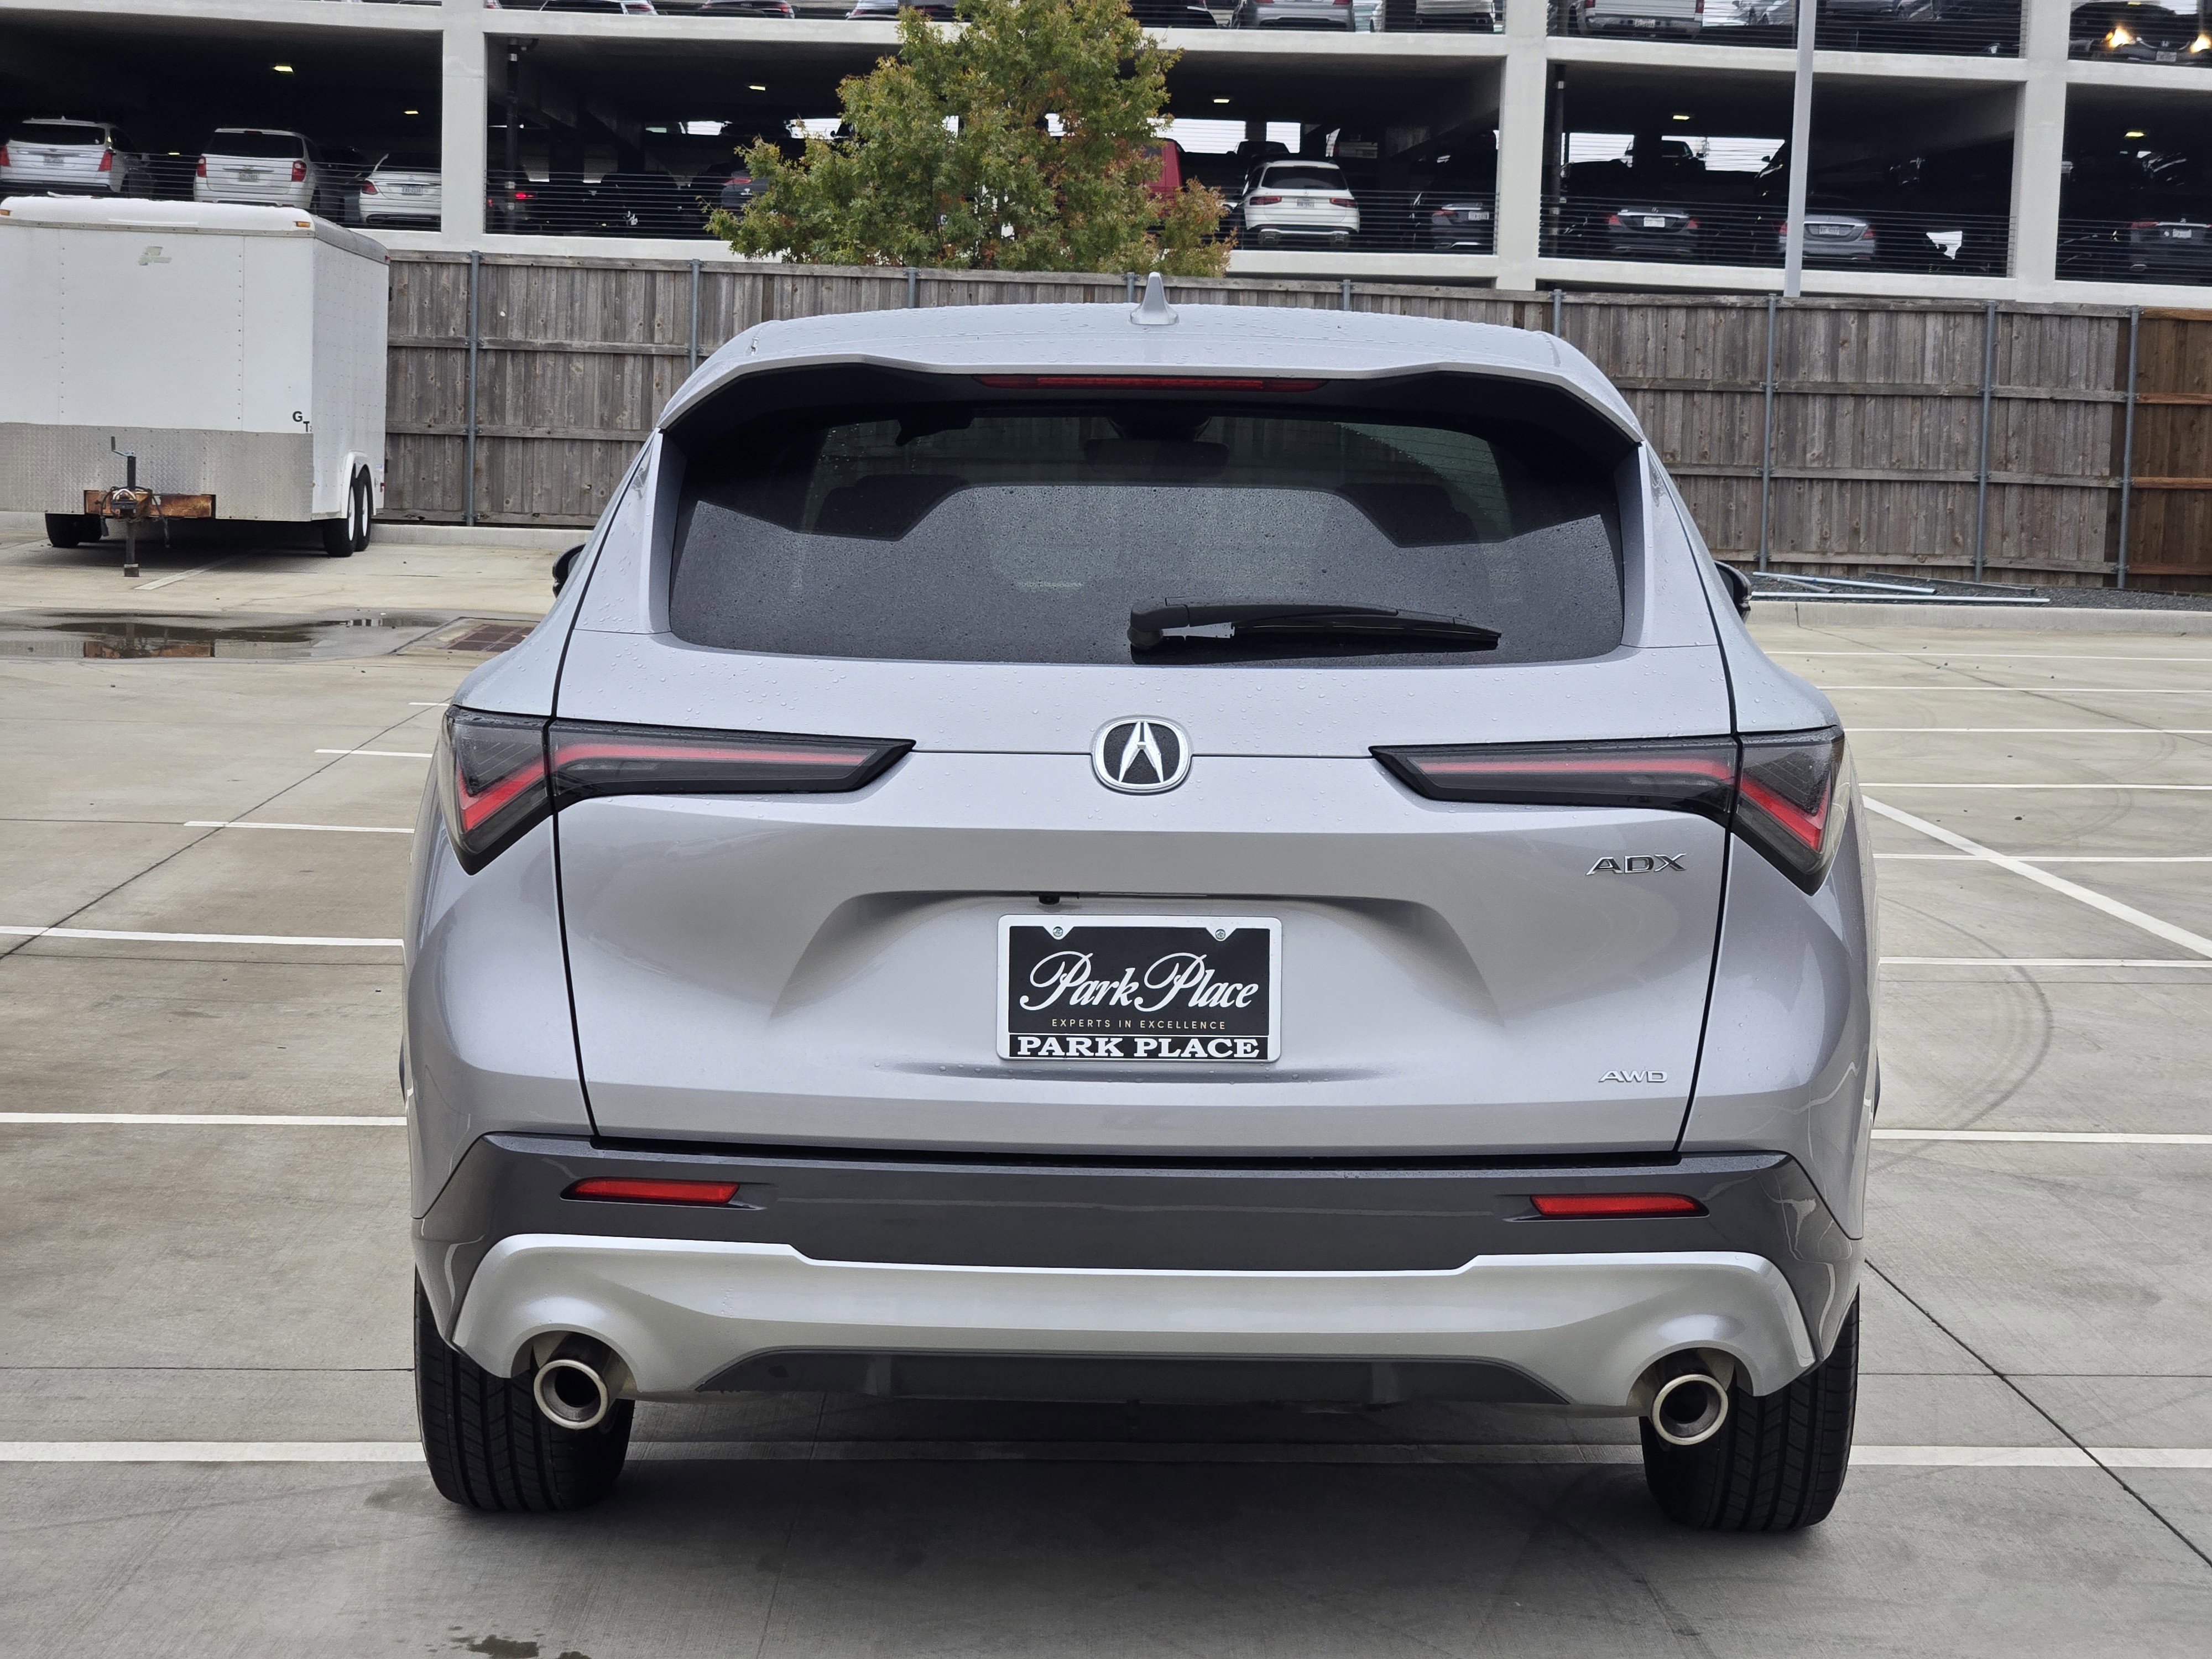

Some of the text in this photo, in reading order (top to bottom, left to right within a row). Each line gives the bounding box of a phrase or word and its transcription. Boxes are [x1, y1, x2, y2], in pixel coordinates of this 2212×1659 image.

[1586, 853, 1687, 875] ADX
[1019, 951, 1259, 1012] Park Place
[1052, 1019, 1225, 1030] EXPERTS IN EXCELLENCE
[1017, 1036, 1260, 1058] PARK PLACE
[1598, 1070, 1667, 1083] AWD
